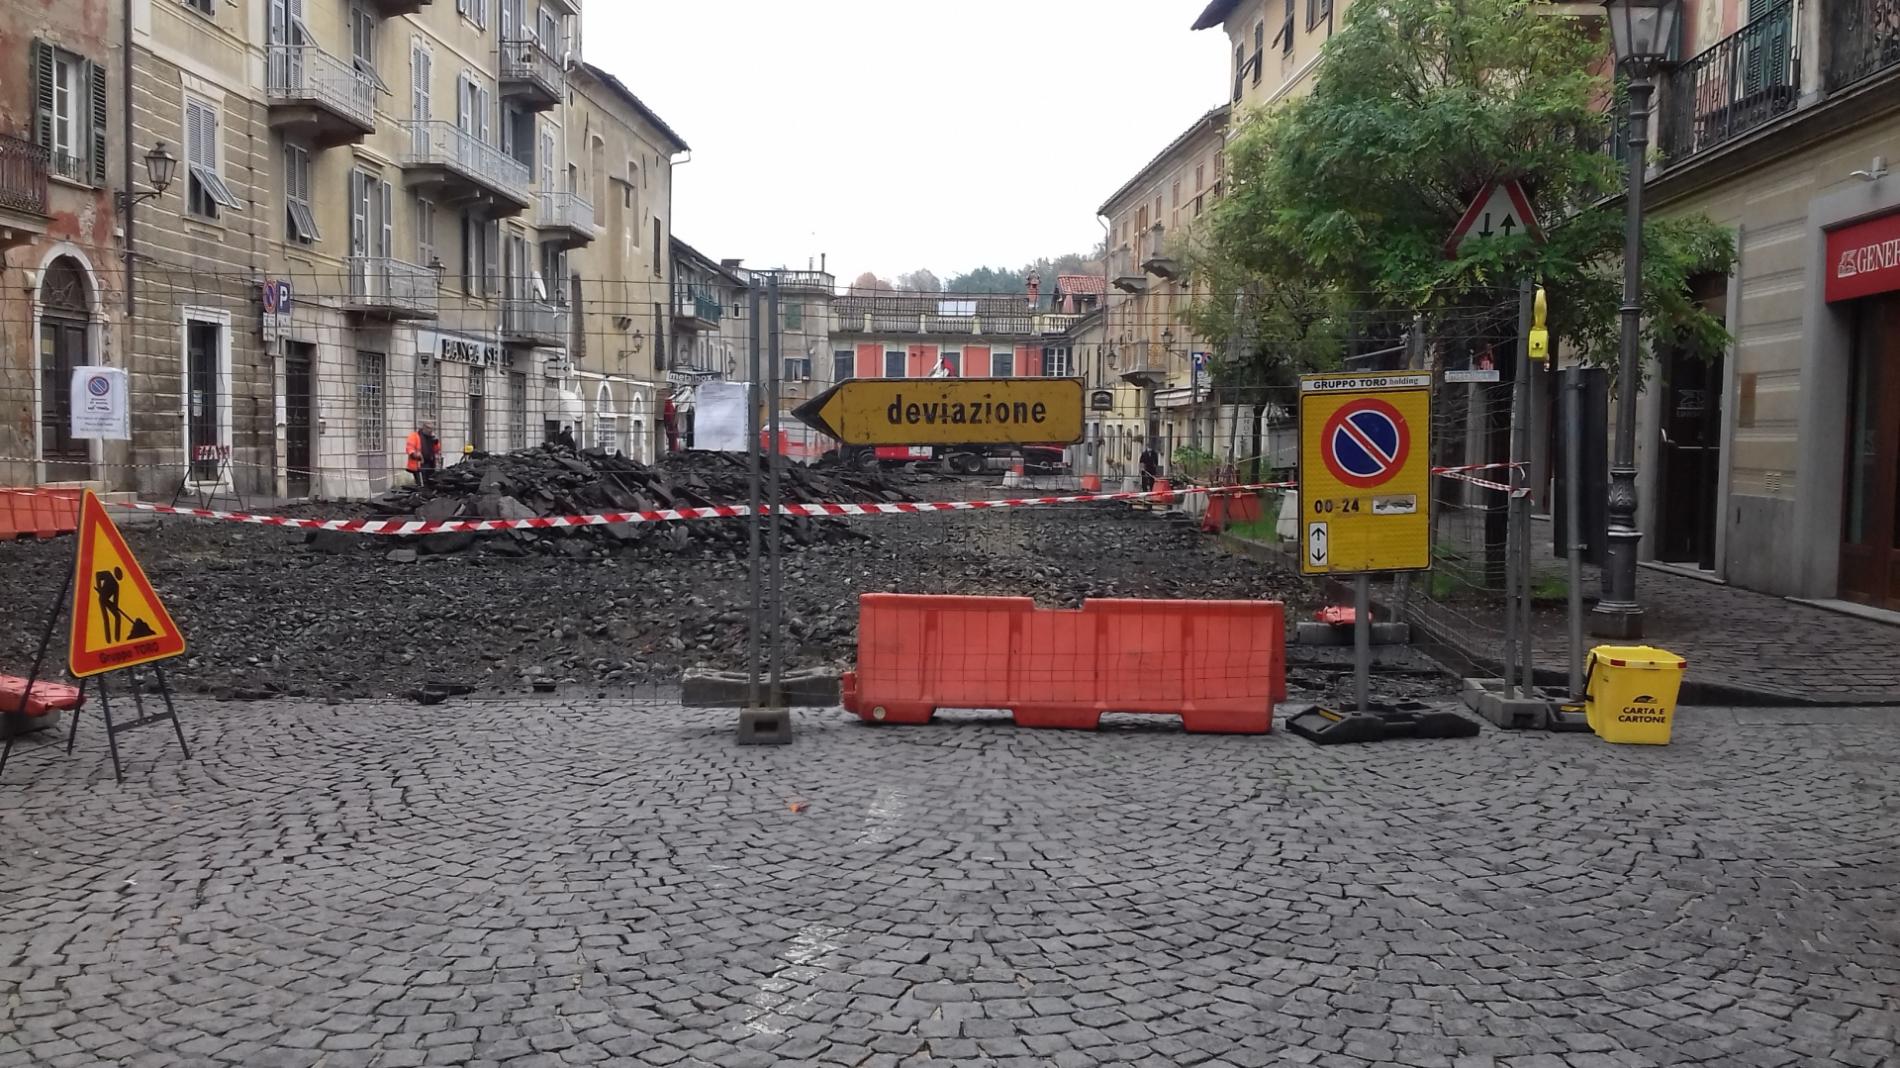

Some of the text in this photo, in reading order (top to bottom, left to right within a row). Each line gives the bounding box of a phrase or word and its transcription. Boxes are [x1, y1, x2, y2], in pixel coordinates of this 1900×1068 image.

[280, 285, 288, 307] P
[442, 339, 480, 364] BANCA
[1313, 377, 1419, 389] GRUPPO TORO holding
[887, 394, 1047, 424] deviazione
[134, 641, 159, 655] TORO
